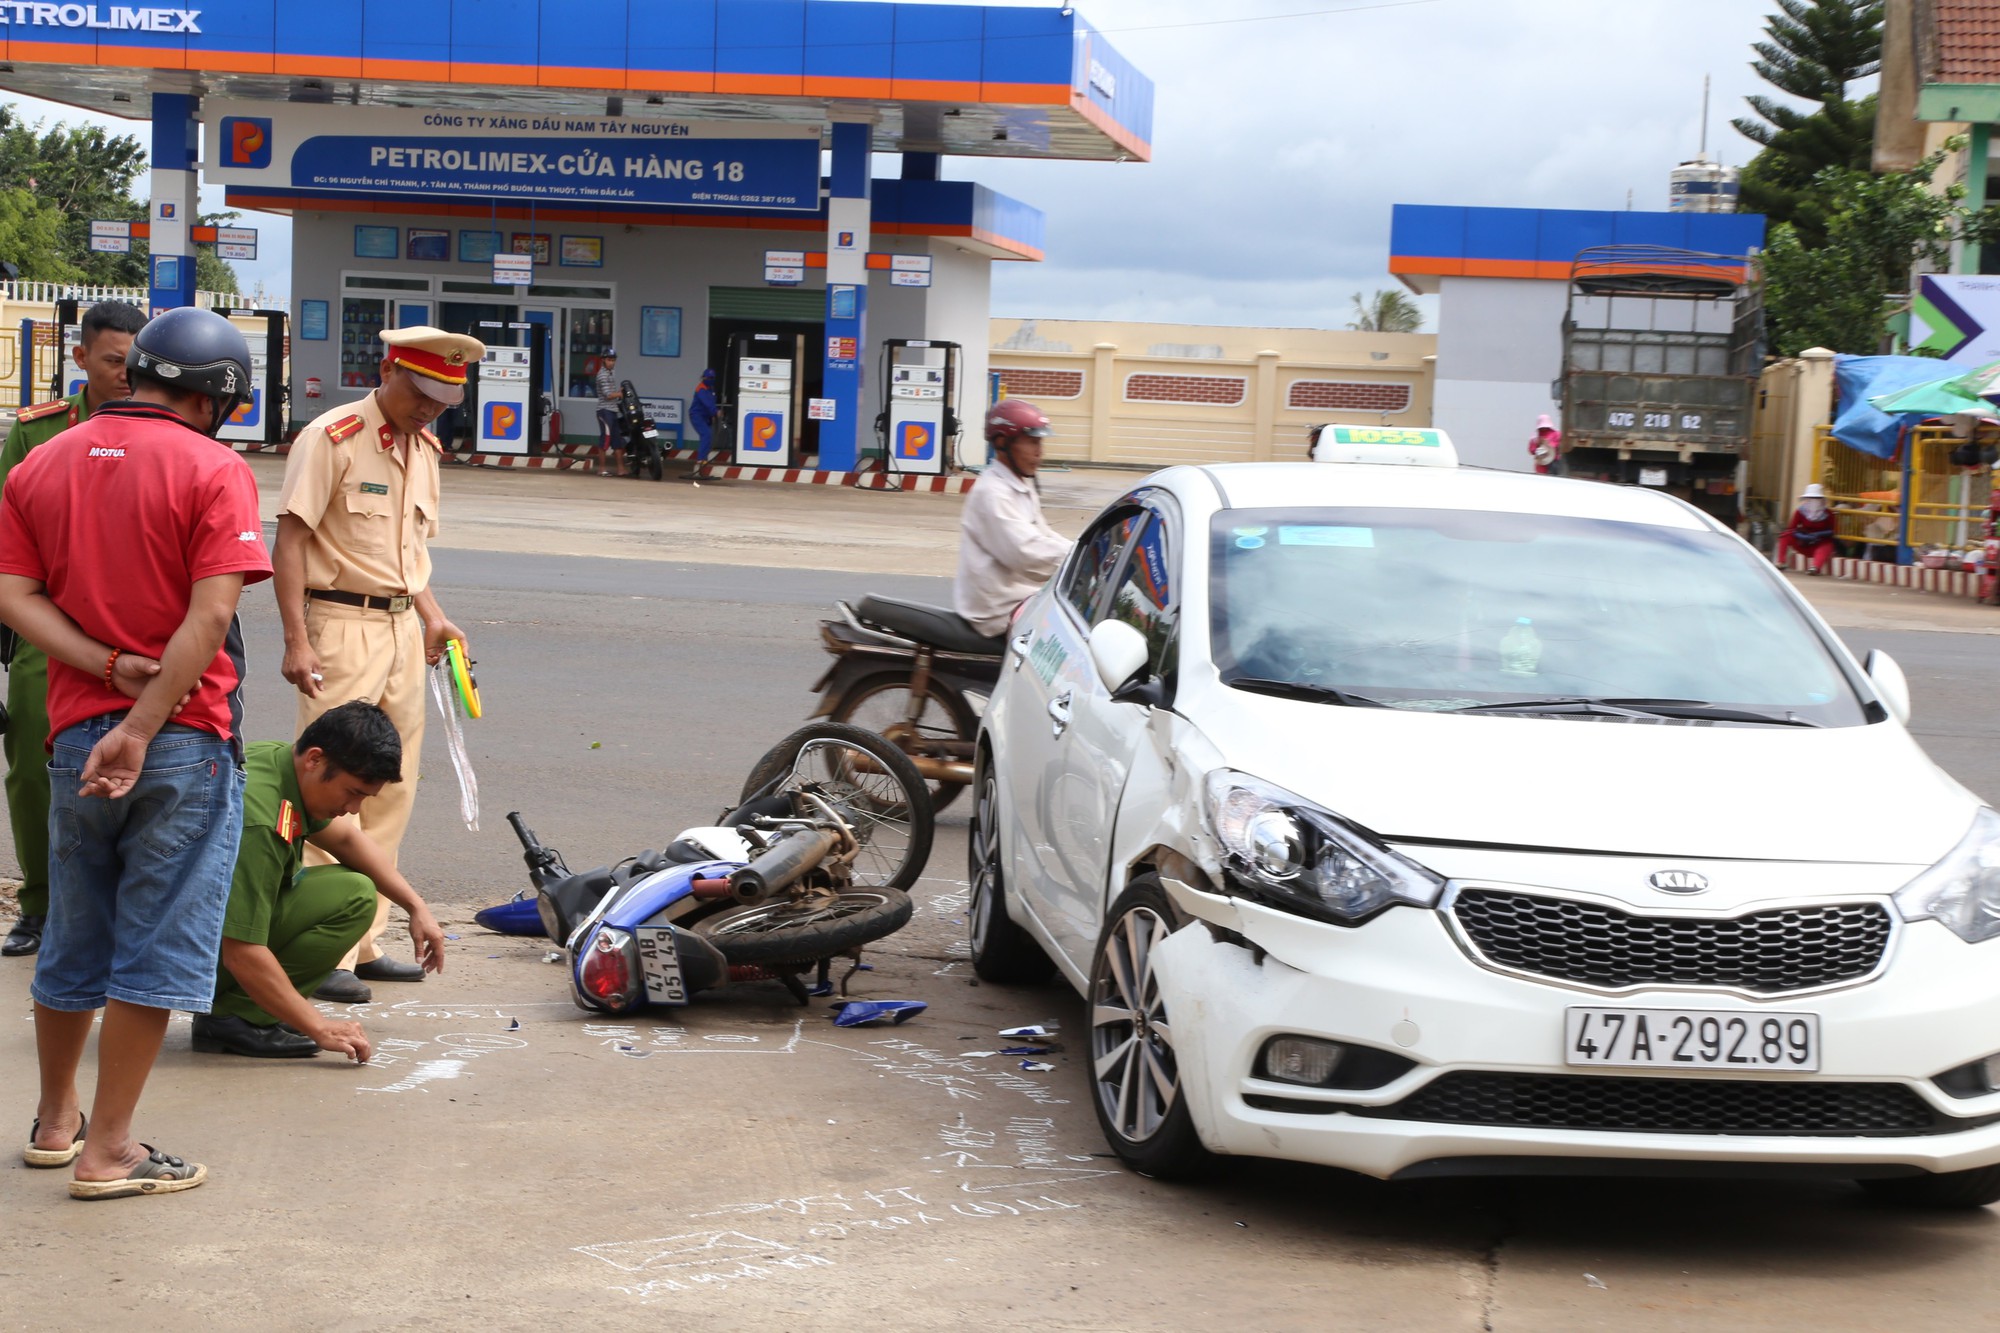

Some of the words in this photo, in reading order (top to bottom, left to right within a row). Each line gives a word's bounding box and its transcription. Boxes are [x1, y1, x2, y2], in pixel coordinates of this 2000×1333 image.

[423, 113, 463, 127] CÔNG
[467, 116, 485, 128] TY
[565, 121, 595, 132] NAM
[599, 120, 627, 133] TÂY
[624, 154, 703, 181] HÀNG
[712, 161, 745, 182] 18
[88, 447, 126, 458] MOTUL
[1654, 871, 1708, 890] KIA
[639, 938, 664, 993] 47-AB
[656, 931, 684, 1000] 051.49
[1575, 1012, 1810, 1065] 47A-292.89
